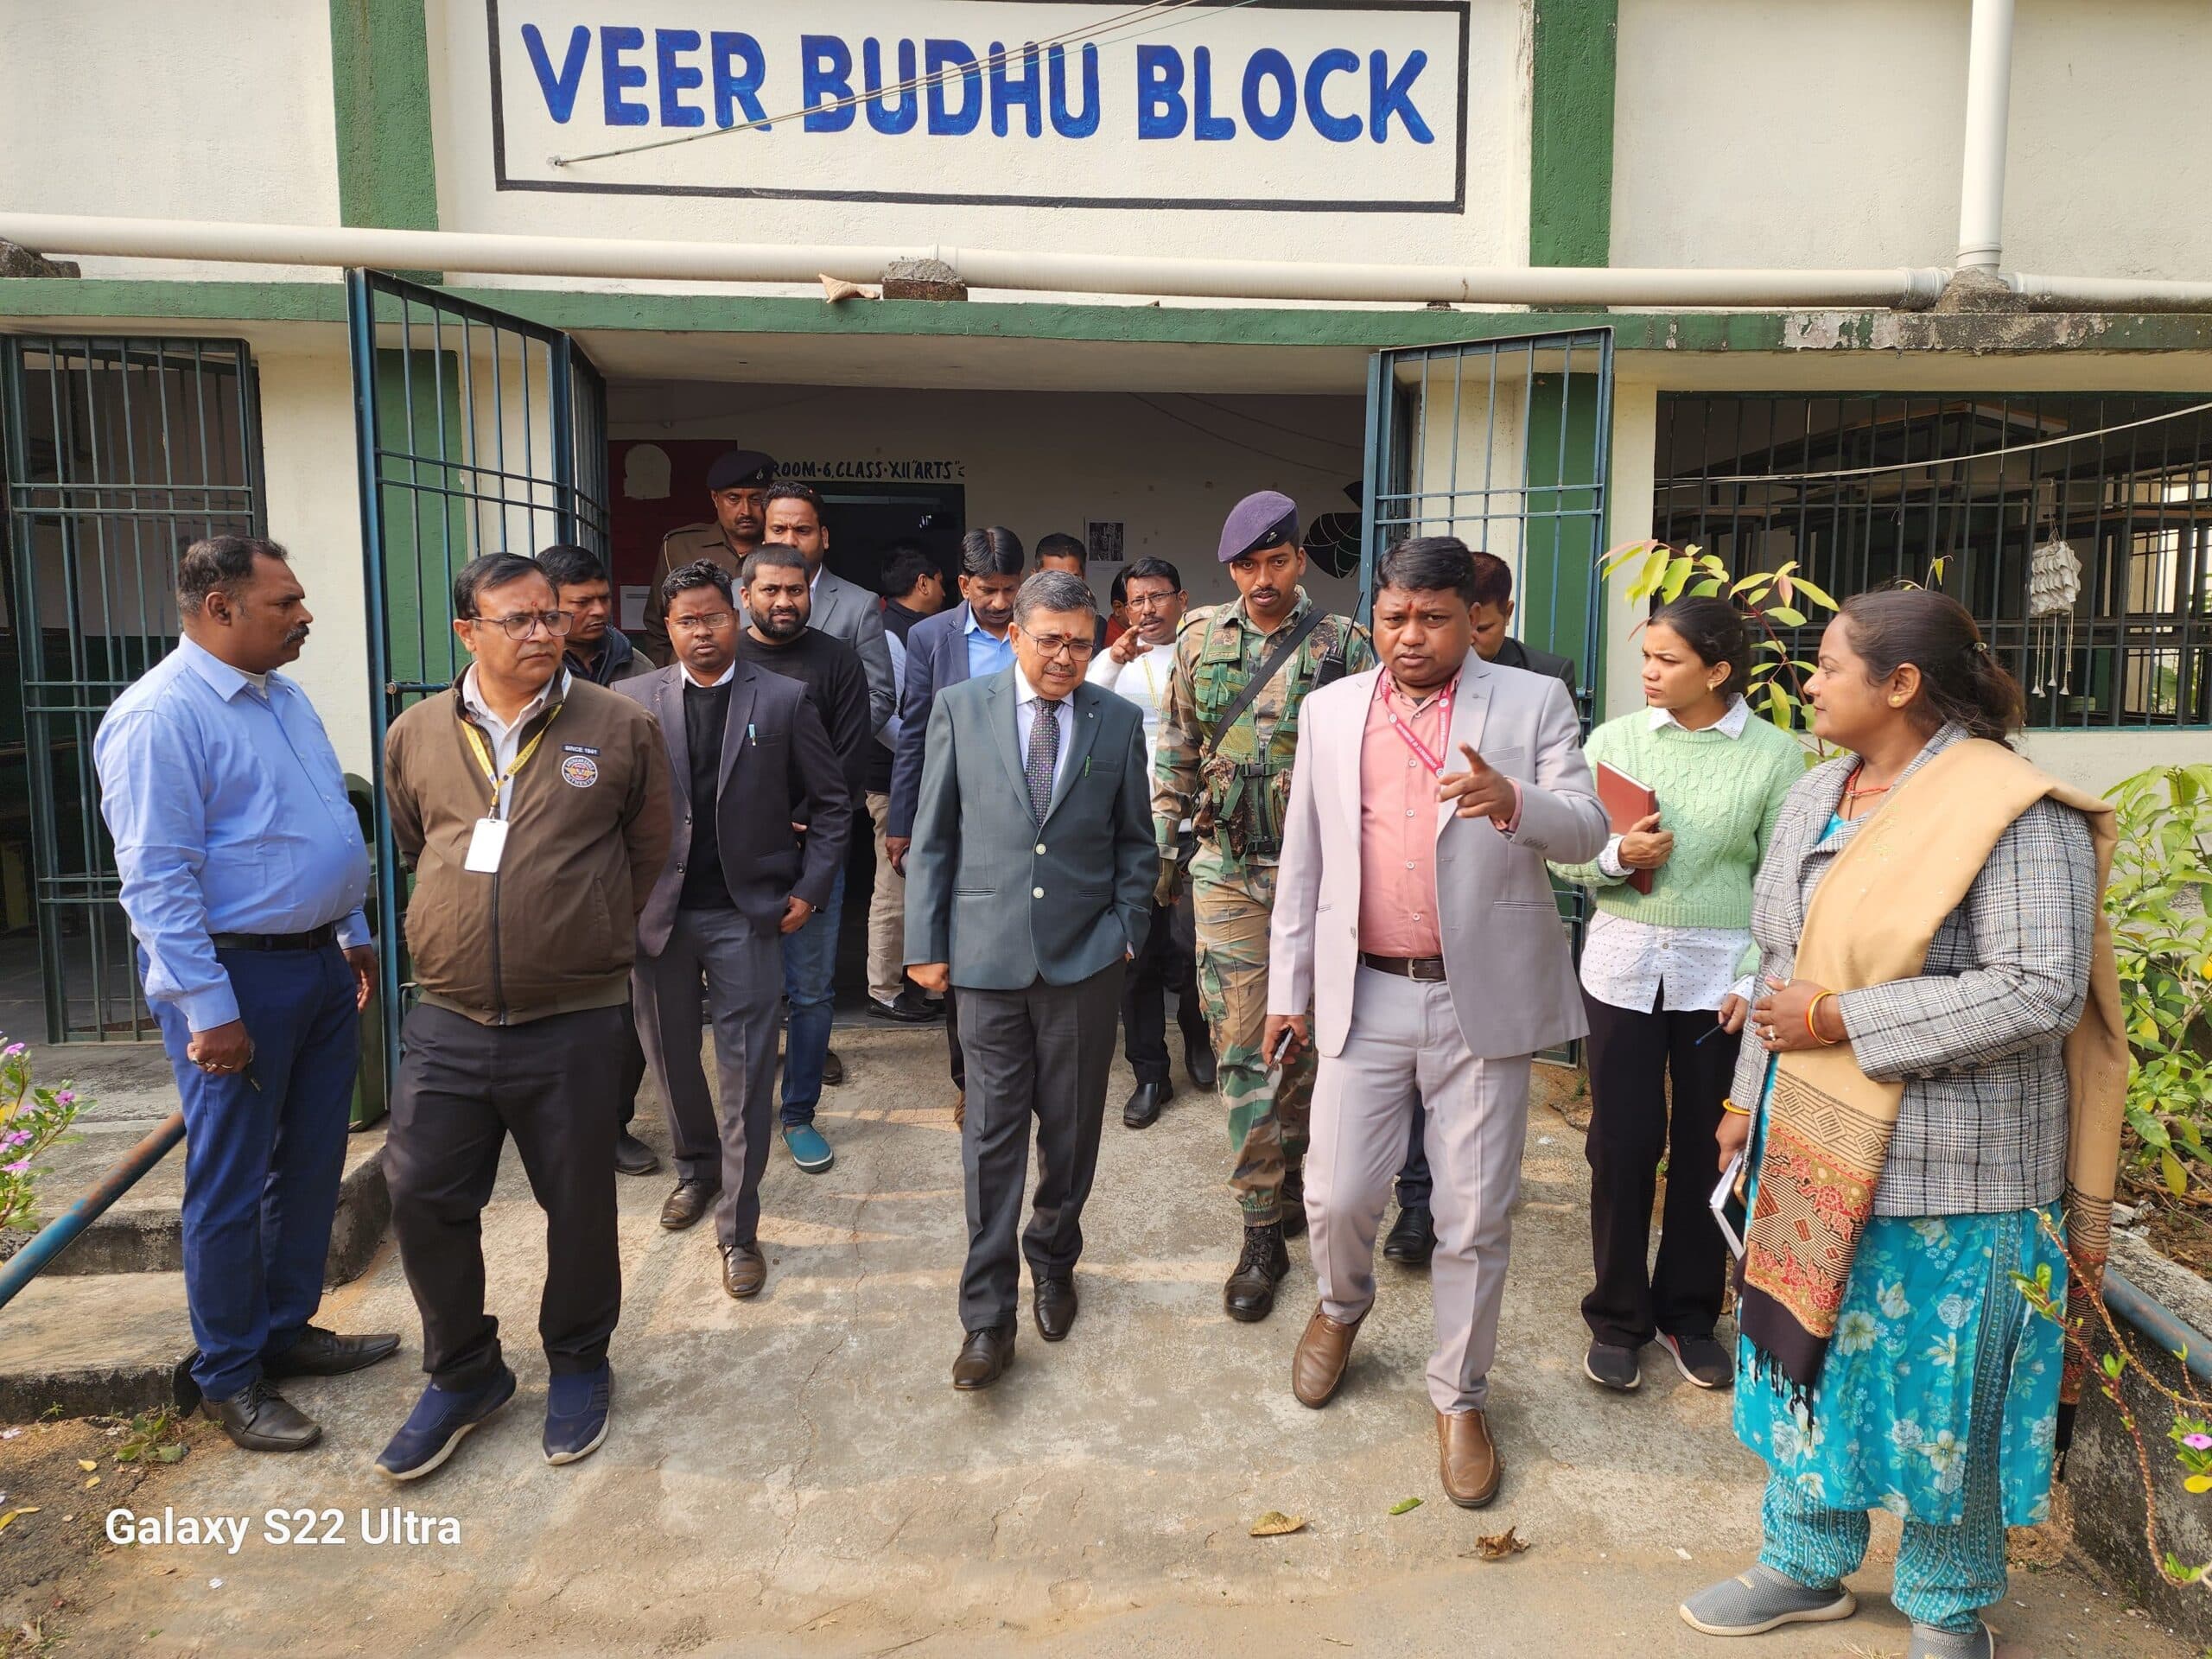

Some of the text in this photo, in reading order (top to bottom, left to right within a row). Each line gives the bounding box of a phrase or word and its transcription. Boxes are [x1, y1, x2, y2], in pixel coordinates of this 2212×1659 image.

[520, 23, 1436, 145] VEER BUDHU BLOCK
[564, 745, 584, 753] SINCE
